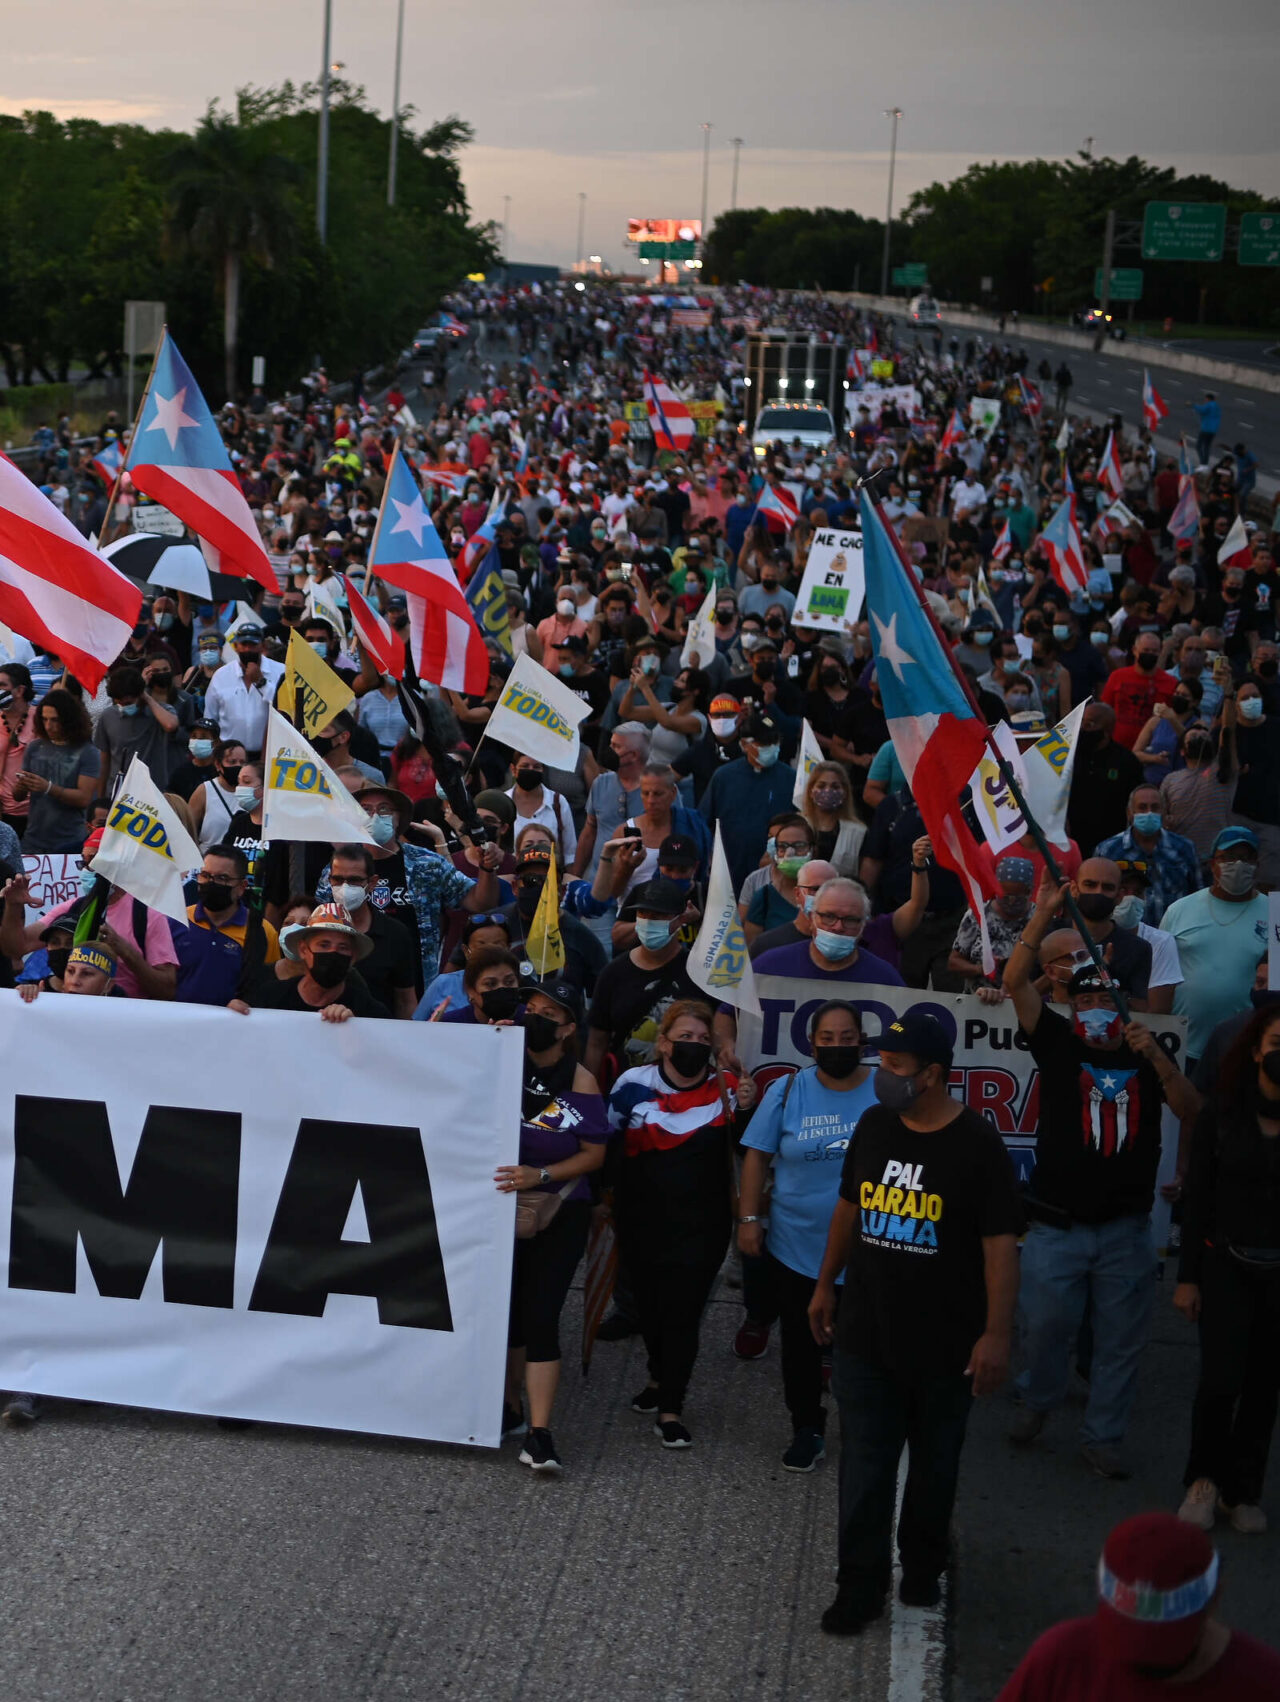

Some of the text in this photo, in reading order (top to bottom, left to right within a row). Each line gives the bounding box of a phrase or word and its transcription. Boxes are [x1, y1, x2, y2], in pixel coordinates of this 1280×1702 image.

[815, 533, 835, 546] ME
[824, 572, 844, 586] EN
[810, 1123, 848, 1139] ESCUELA
[880, 1159, 924, 1192] PAL
[859, 1180, 944, 1222] CARAJO
[860, 1208, 939, 1248] LUMA
